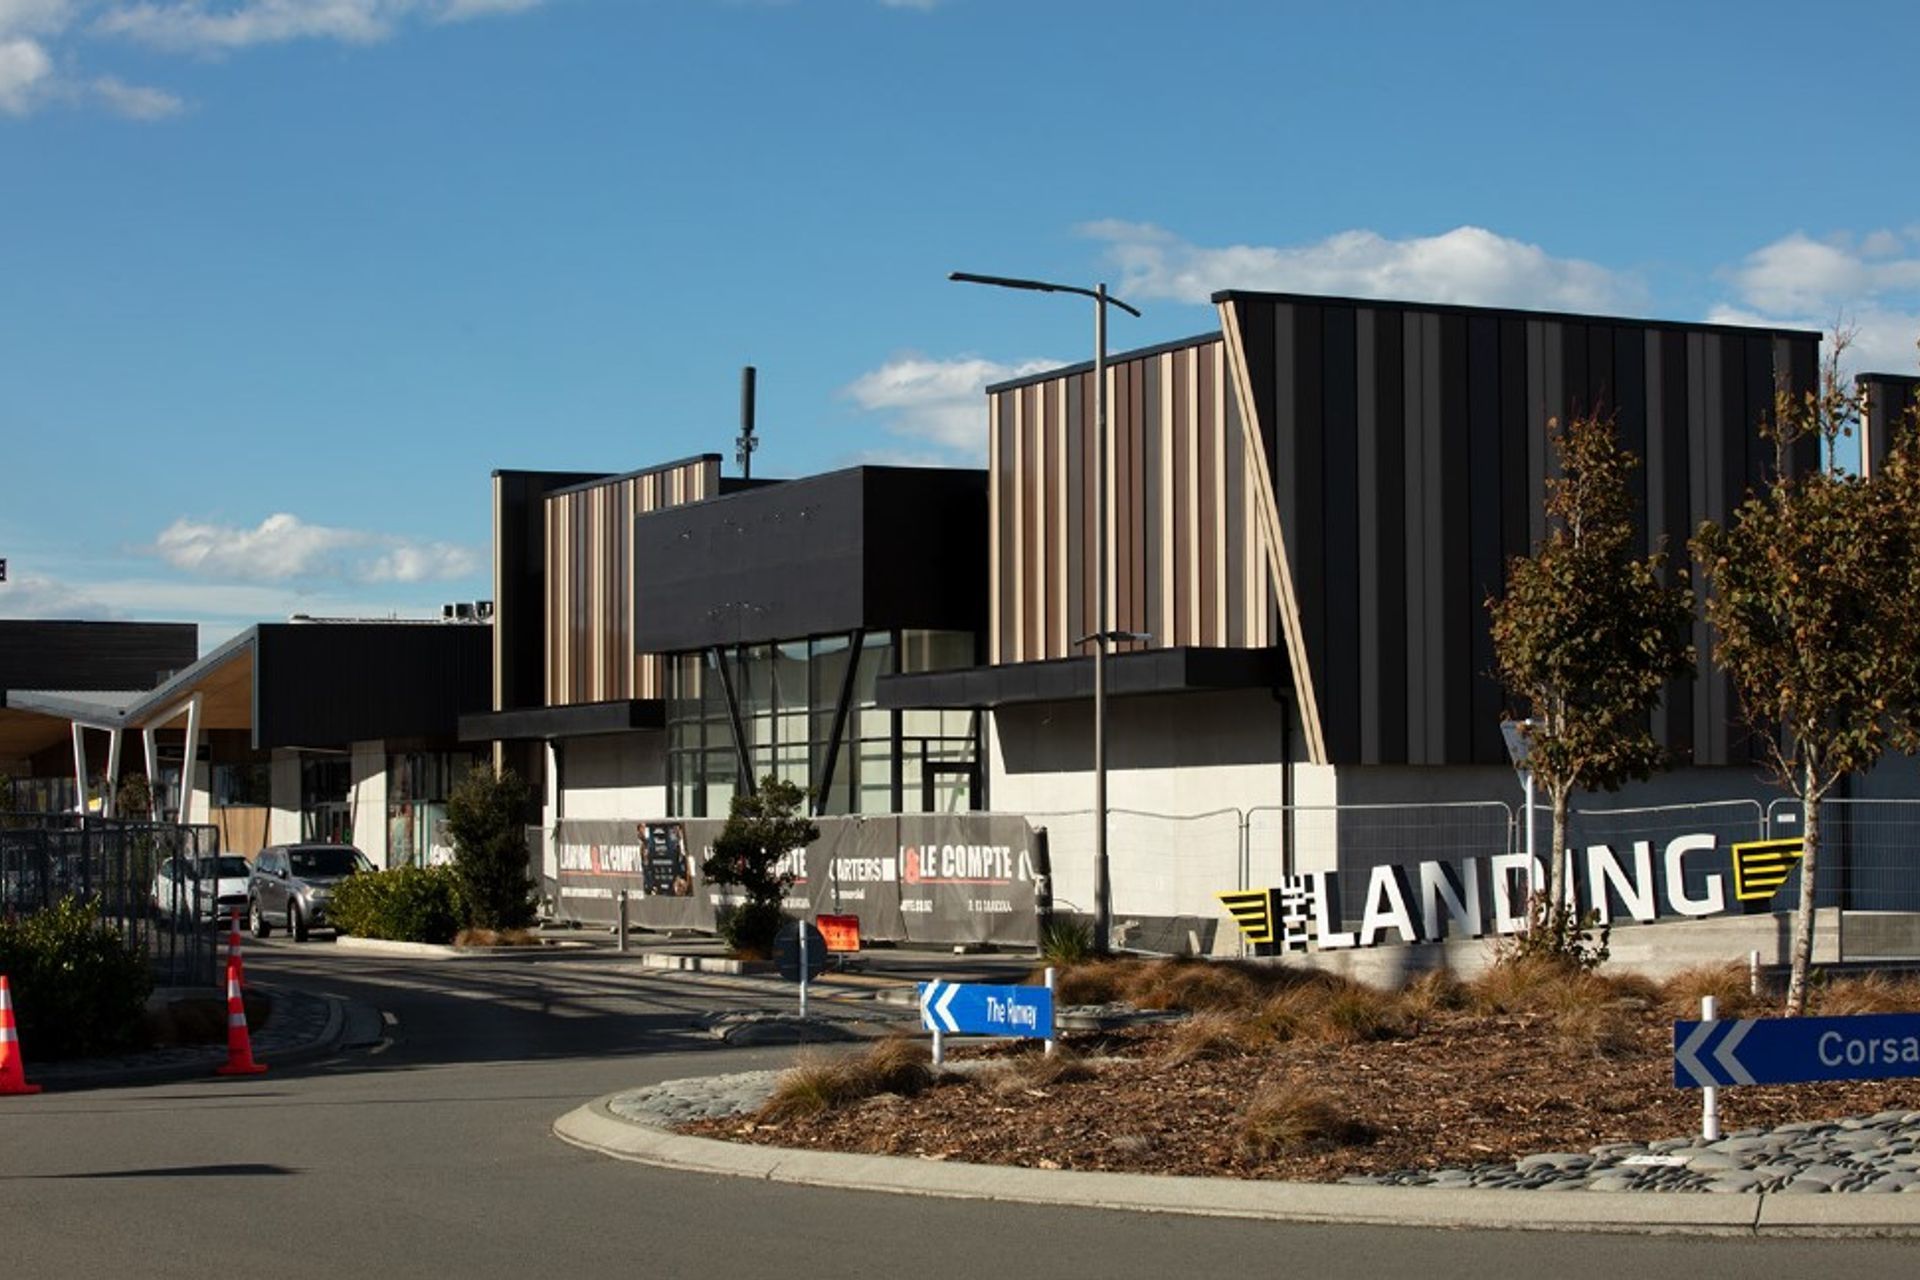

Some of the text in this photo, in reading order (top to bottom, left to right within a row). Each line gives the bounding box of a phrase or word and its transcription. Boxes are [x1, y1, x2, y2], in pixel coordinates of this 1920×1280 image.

[919, 844, 937, 878] LE
[941, 844, 1013, 879] COMPTE
[1281, 874, 1306, 951] THE
[1314, 833, 1725, 947] LANDING
[986, 996, 1006, 1024] The
